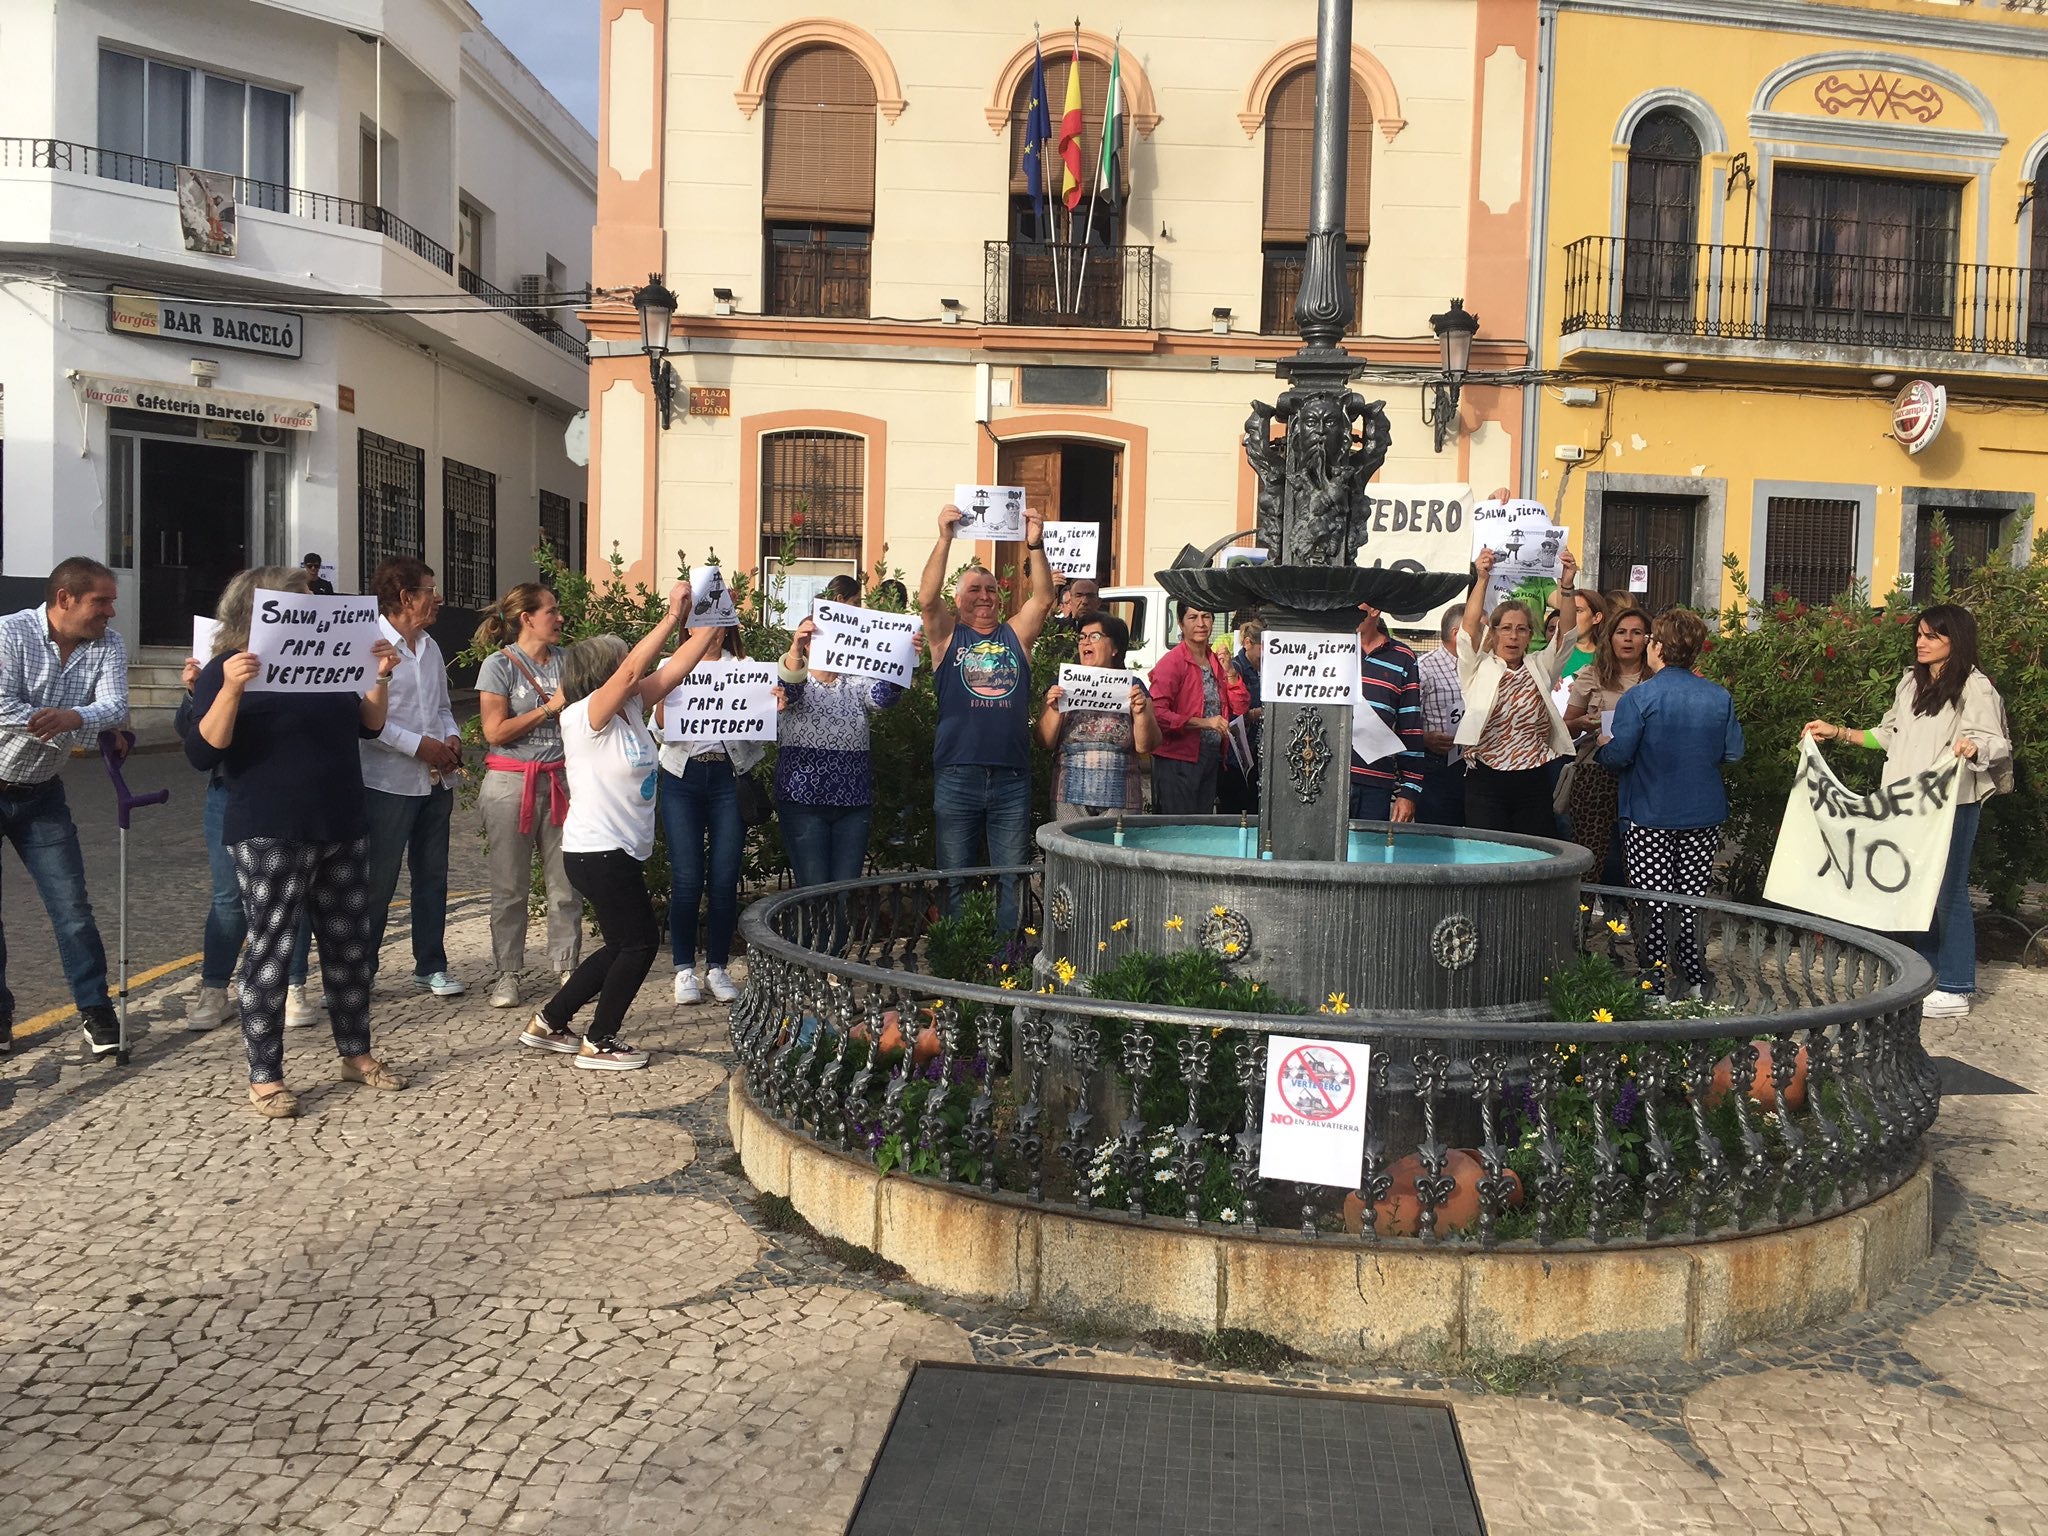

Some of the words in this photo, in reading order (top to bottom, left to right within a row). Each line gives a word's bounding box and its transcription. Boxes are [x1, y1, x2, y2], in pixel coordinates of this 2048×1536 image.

[113, 311, 156, 328] Vargas
[163, 309, 202, 334] BAR
[212, 316, 293, 348] BARCELÓ
[85, 388, 128, 404] Vargas
[701, 389, 727, 398] PLAZA
[690, 405, 729, 415] ESPAÑA
[704, 398, 715, 406] DE
[206, 403, 265, 423] Barceló
[273, 413, 312, 428] Vargas
[1370, 499, 1462, 533] EDERO
[1474, 507, 1506, 520] SALVA
[1070, 548, 1081, 557] EL
[261, 600, 317, 624] SALVA
[819, 606, 859, 626] SALVA
[280, 639, 325, 656] PARA
[333, 642, 351, 656] EL
[834, 633, 869, 649] PARA
[876, 642, 892, 653] EL
[1269, 638, 1306, 654] SALVA
[826, 650, 904, 676] VERTEDERO
[1284, 664, 1316, 677] PARA
[1322, 667, 1336, 677] EL
[266, 664, 364, 684] VERTEDERO
[681, 673, 712, 686] ALVA
[1063, 669, 1091, 682] SALVA
[1074, 688, 1097, 697] PARA
[1277, 682, 1350, 697] VERTEDERO
[687, 697, 723, 710] PARA
[731, 699, 748, 710] EL
[1068, 698, 1122, 709] VERTEDERO
[680, 718, 764, 734] VERTEDERO
[1817, 828, 1911, 893] NO
[1270, 1113, 1293, 1126] NO
[1294, 1118, 1304, 1126] EN
[1306, 1119, 1360, 1132] SALVATIERRA
